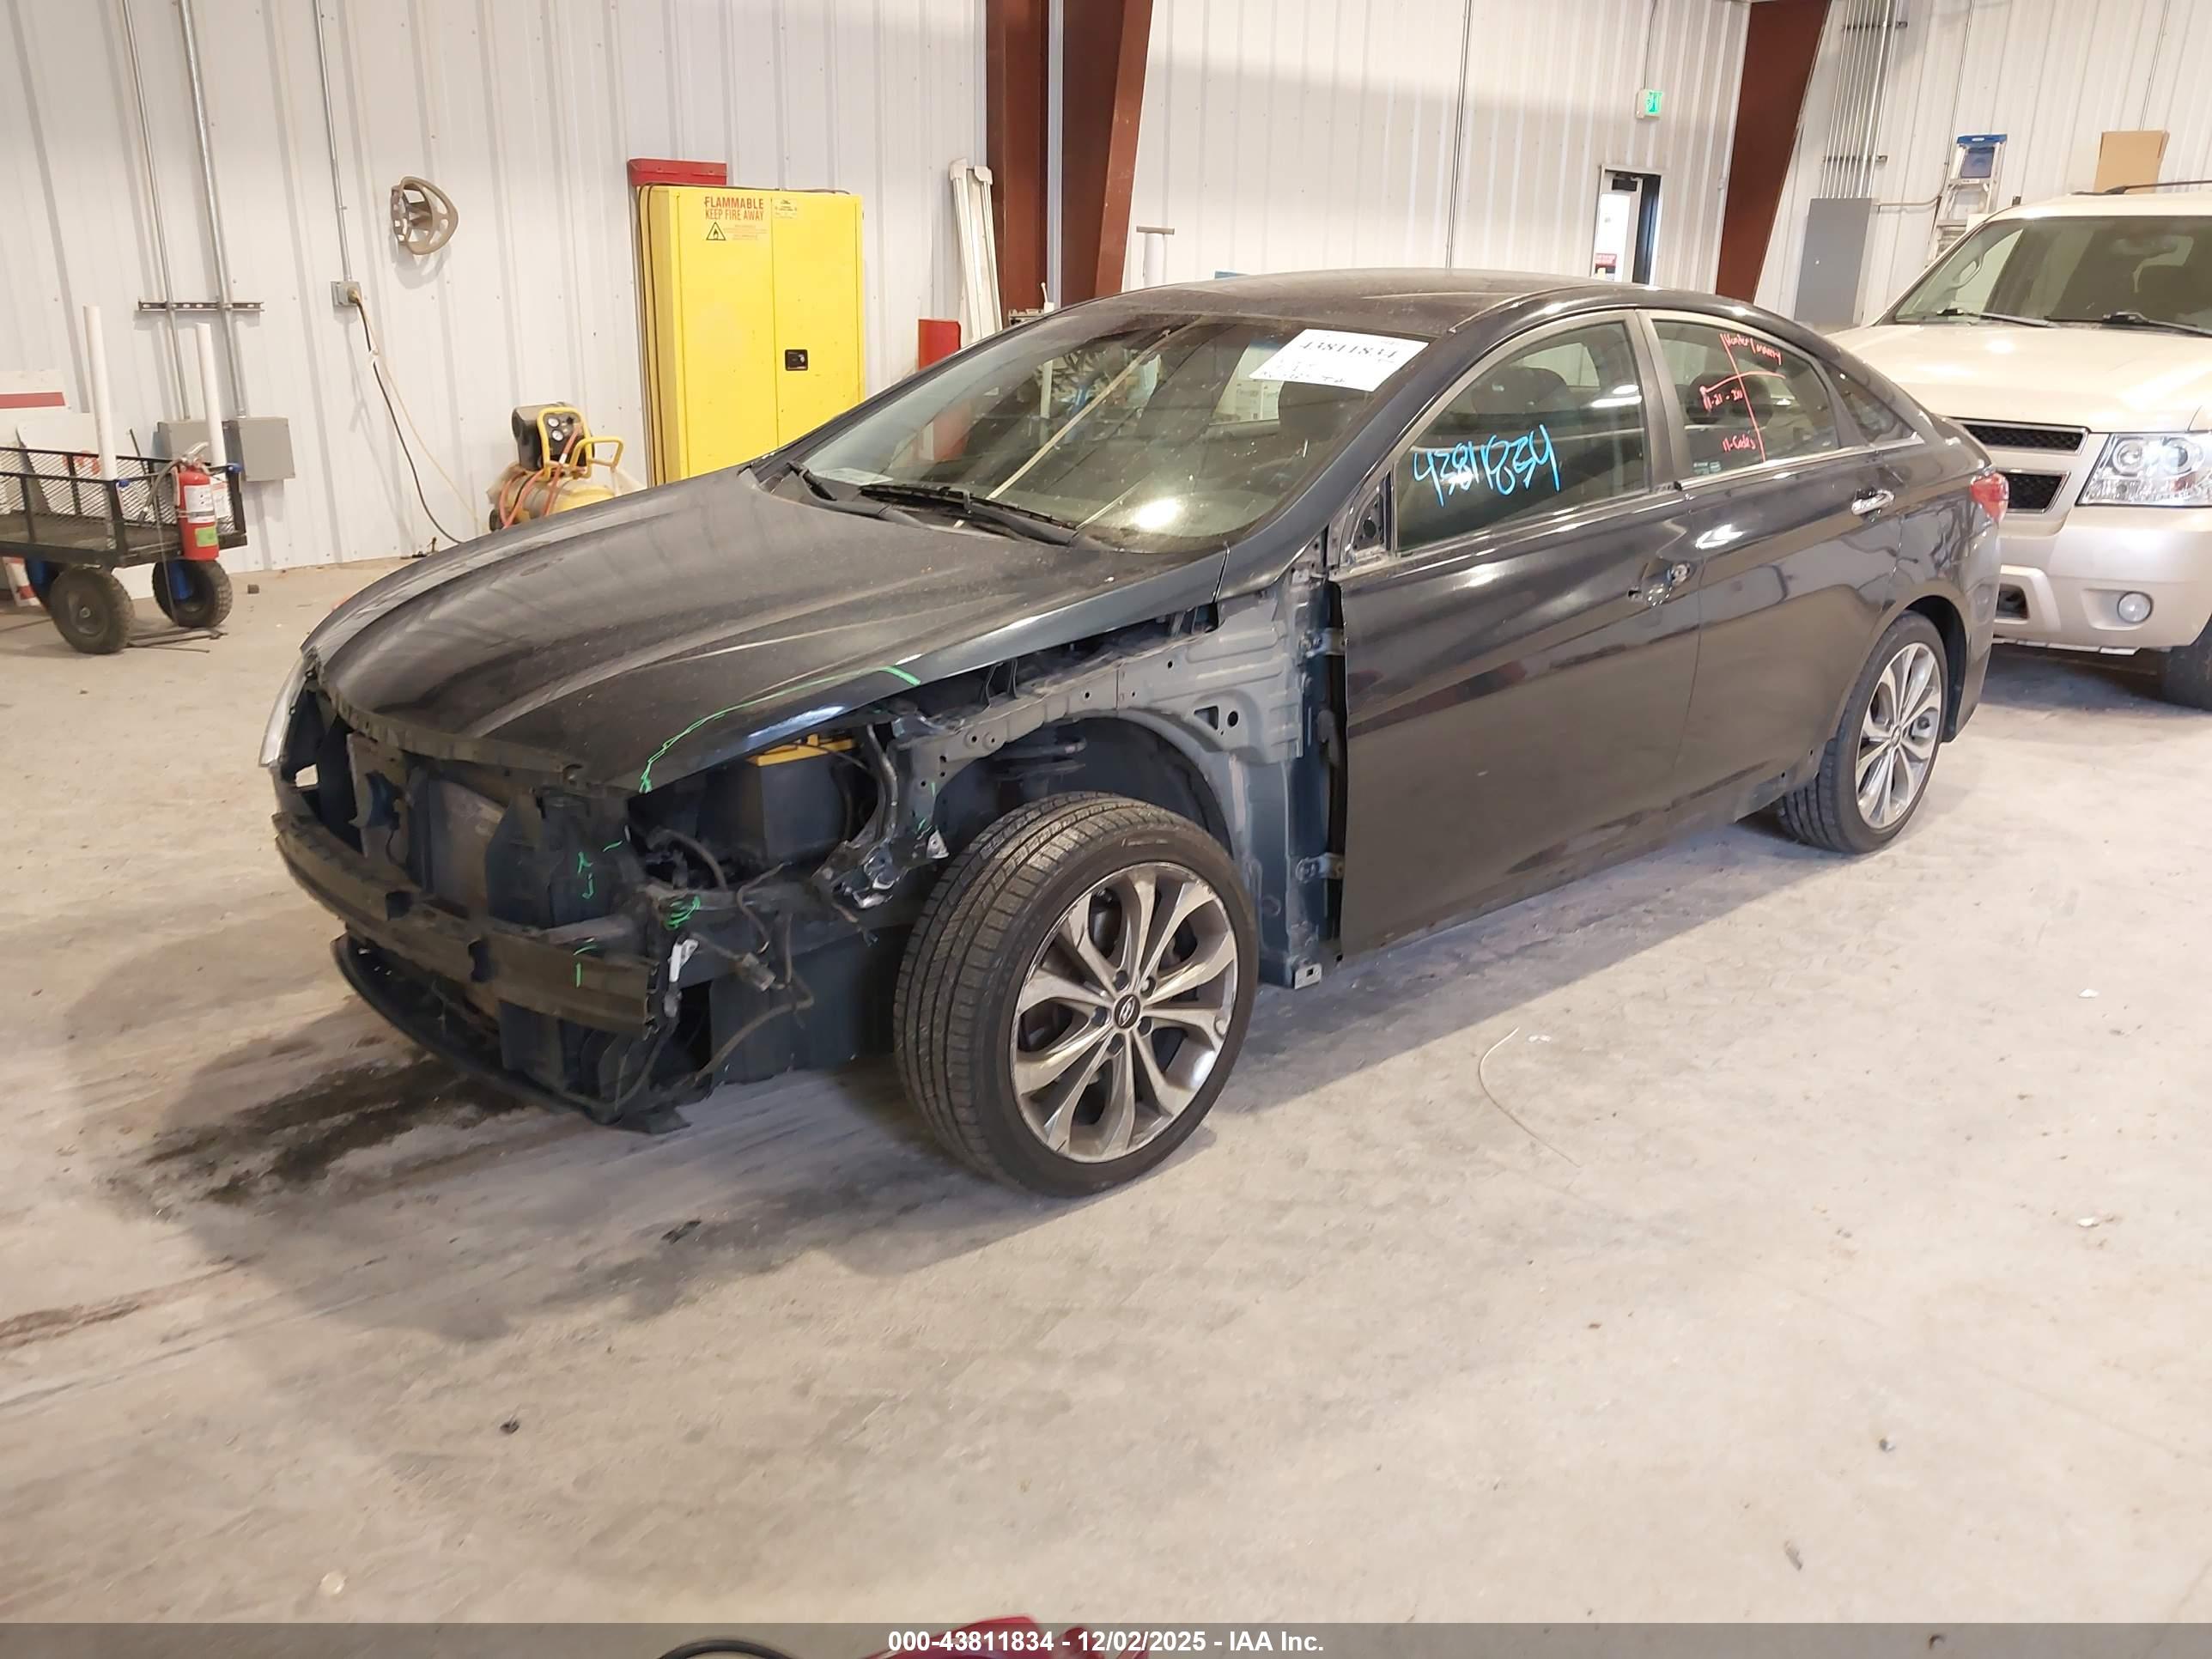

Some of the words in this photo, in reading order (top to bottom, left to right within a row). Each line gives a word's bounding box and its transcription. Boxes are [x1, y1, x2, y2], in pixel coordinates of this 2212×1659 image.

[704, 196, 763, 210] FLAMMABLE
[705, 209, 723, 220] KEEP
[725, 209, 741, 221] FIRE
[743, 210, 764, 221] AWAY
[1413, 424, 1560, 507] 43811834
